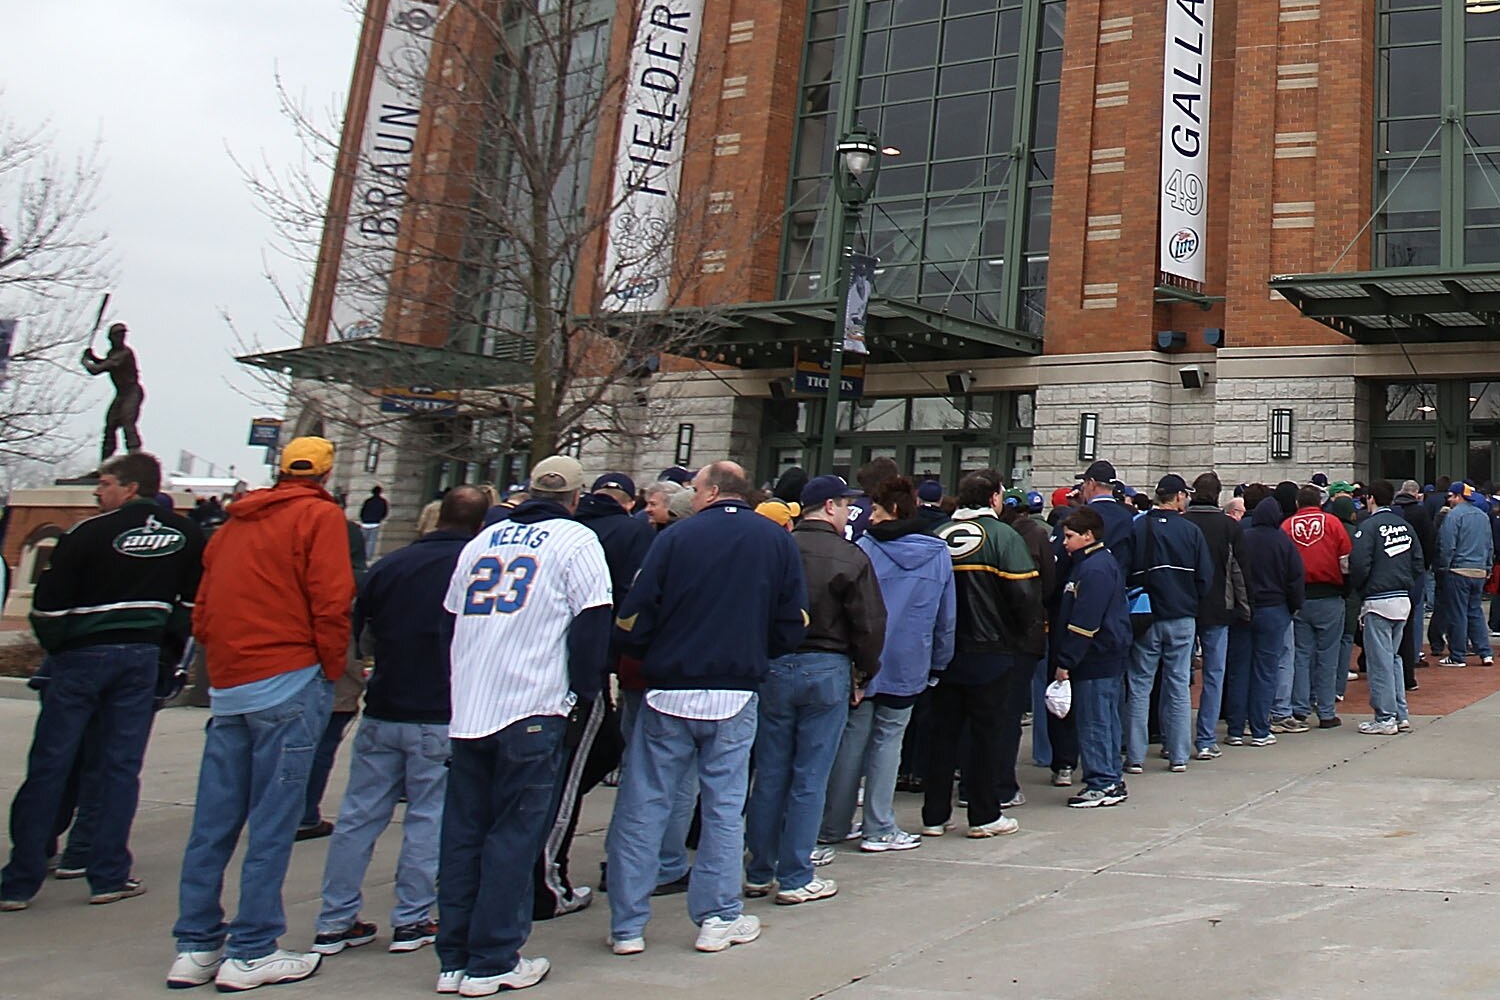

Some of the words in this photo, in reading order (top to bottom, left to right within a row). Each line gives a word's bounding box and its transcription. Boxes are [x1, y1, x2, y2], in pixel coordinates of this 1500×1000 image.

[627, 4, 691, 196] FIELDER
[361, 104, 421, 236] BRAUN
[1165, 168, 1204, 216] 49
[1174, 238, 1195, 258] Lite
[489, 525, 550, 549] WEEKS
[463, 552, 540, 617] 23
